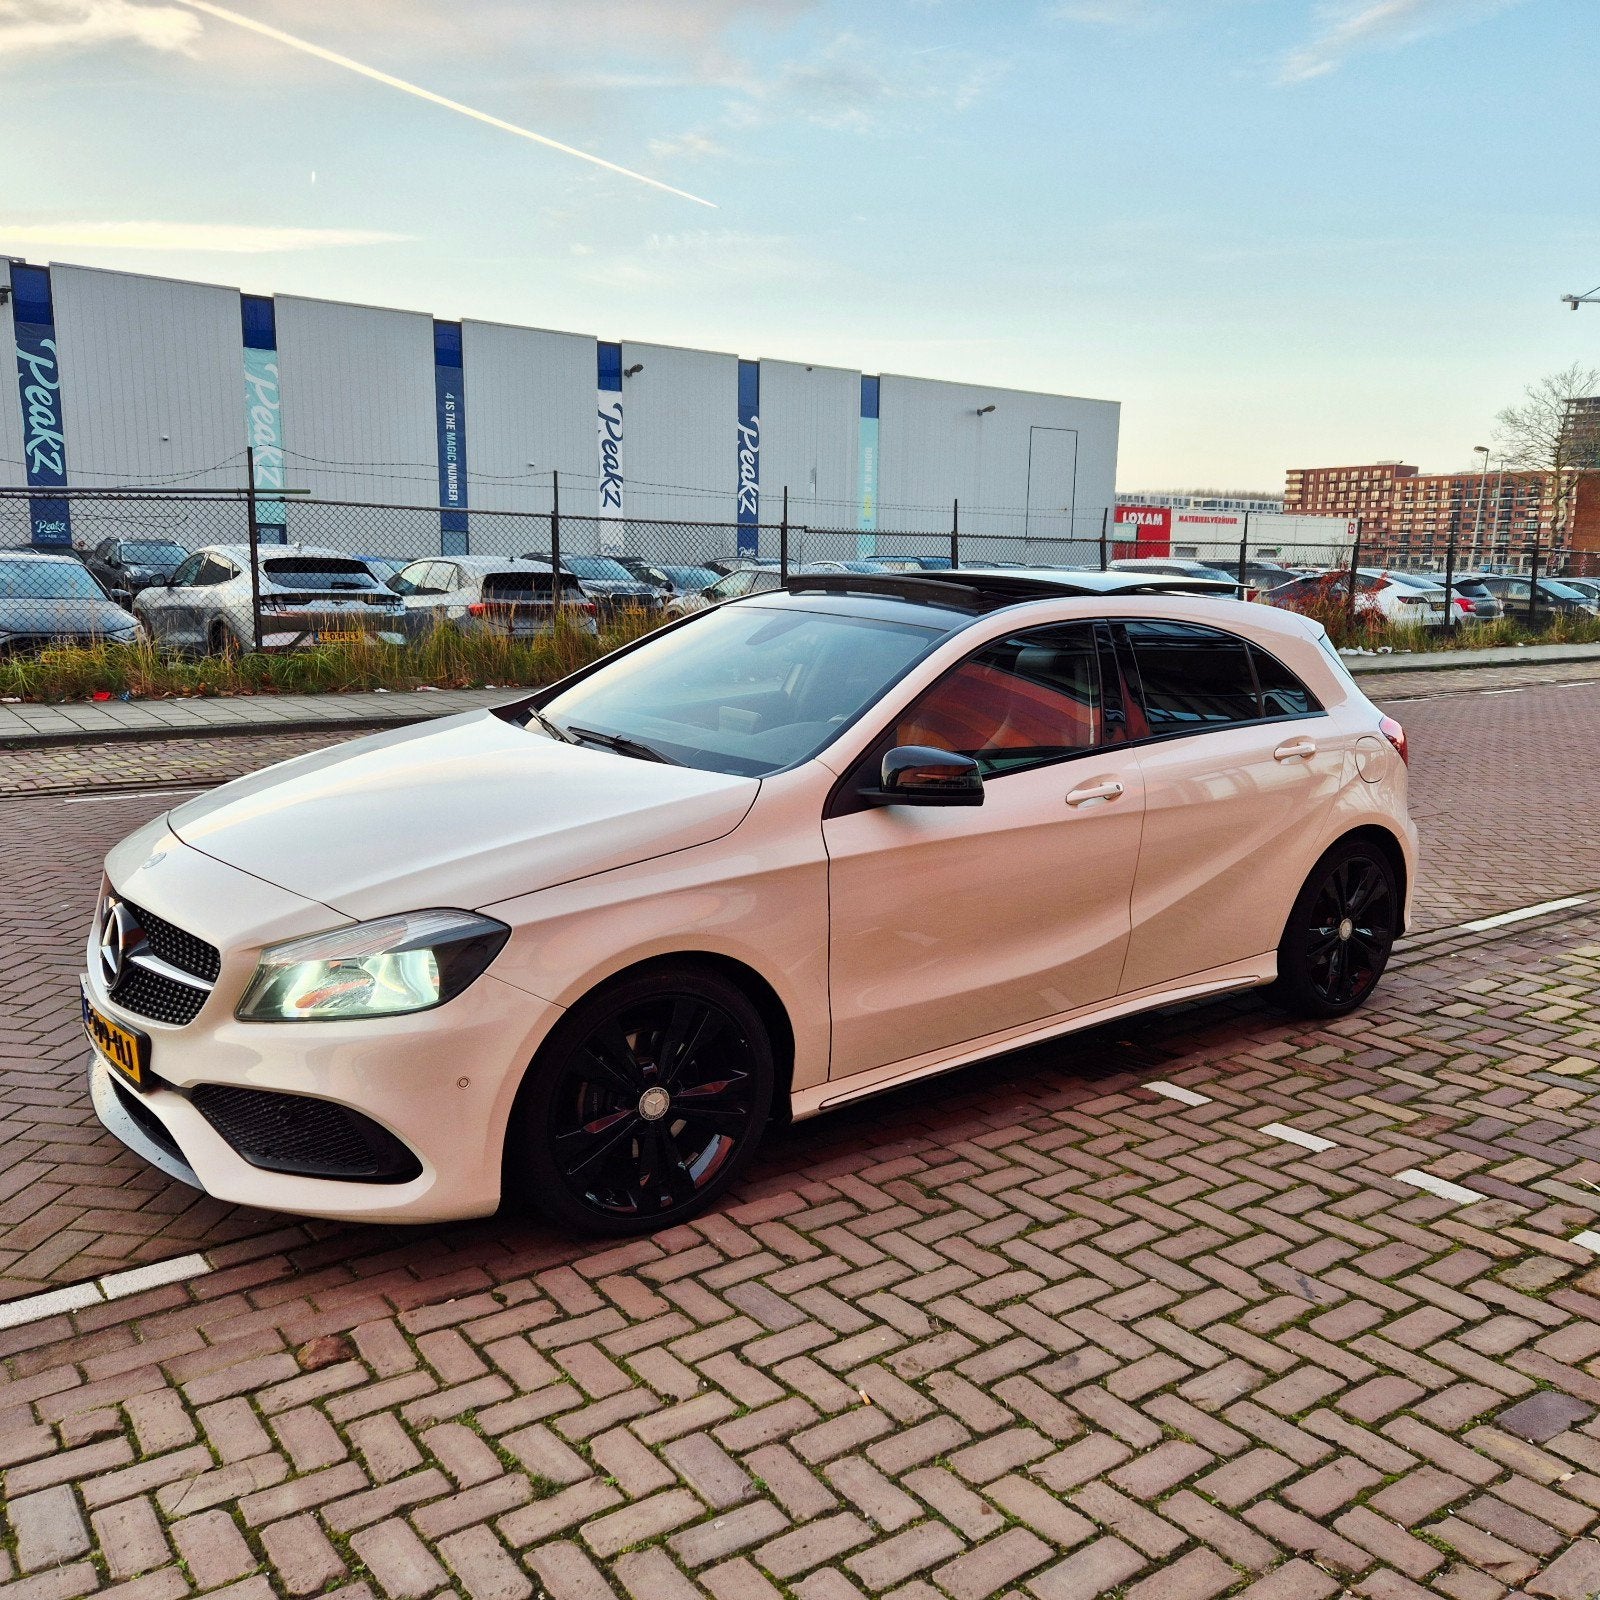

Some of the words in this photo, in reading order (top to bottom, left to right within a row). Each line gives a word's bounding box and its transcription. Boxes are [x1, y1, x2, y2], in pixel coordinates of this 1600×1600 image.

[16, 338, 66, 476] Peakz
[445, 401, 455, 411] IS
[244, 363, 284, 488] Peakz
[445, 412, 456, 431] THE
[446, 431, 457, 461] MAGIC
[598, 402, 624, 509] Peakz
[737, 415, 760, 515] Peakz
[864, 447, 873, 472] BORN
[864, 474, 873, 484] IN
[35, 520, 67, 533] Peakz
[1122, 511, 1164, 526] LOXAM
[1178, 515, 1238, 525] MATERIEELVERHUUR
